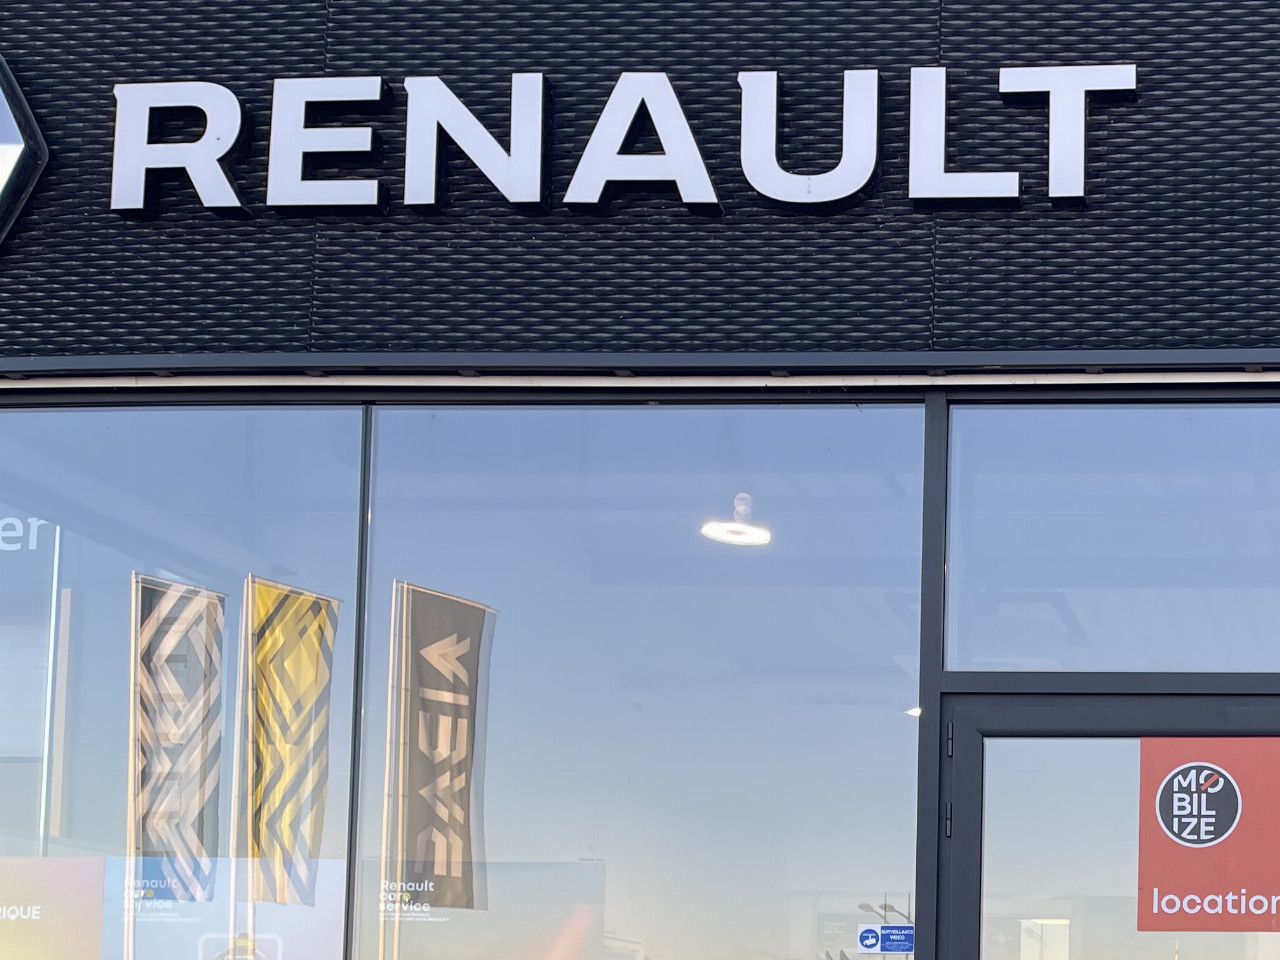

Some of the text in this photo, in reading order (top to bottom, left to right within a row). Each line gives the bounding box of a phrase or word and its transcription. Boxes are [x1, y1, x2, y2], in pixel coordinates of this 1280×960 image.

[110, 64, 1137, 210] RENAULT
[380, 879, 434, 891] Renault
[379, 901, 431, 912] service
